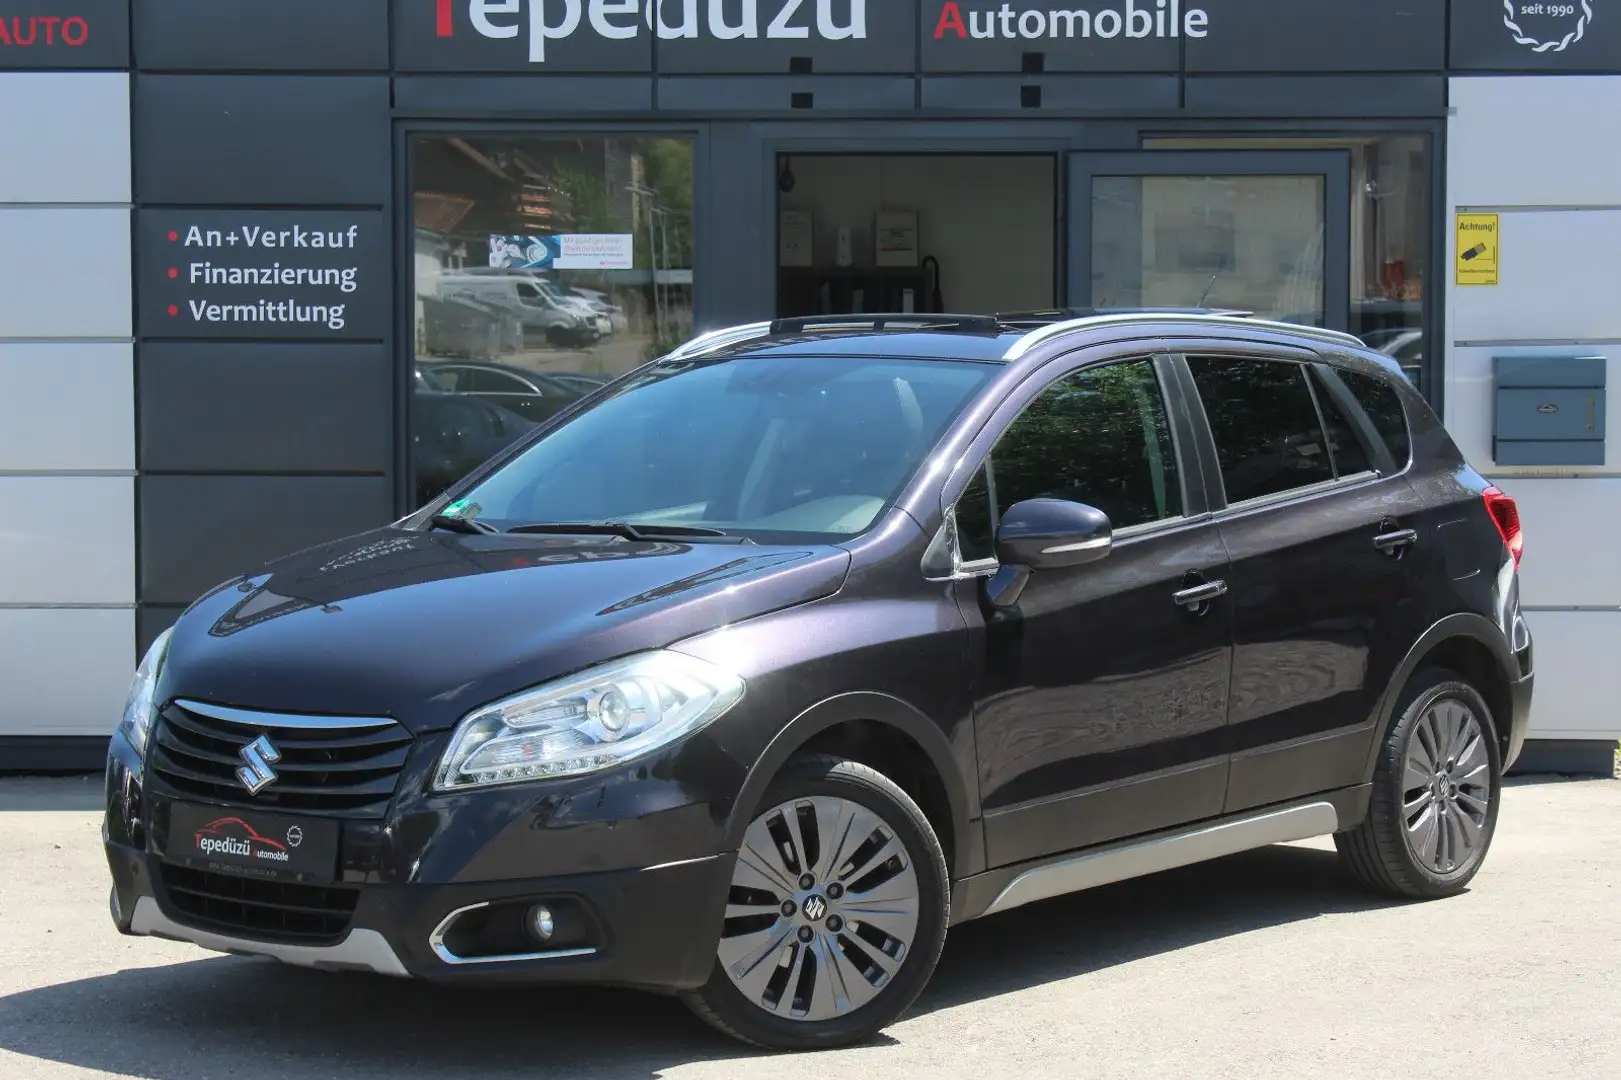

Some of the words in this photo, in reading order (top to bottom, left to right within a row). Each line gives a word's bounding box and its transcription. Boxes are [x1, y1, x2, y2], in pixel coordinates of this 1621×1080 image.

[934, 0, 1208, 39] Automobile
[1521, 3, 1543, 14] seit
[1546, 5, 1574, 17] 1990
[184, 225, 358, 248] An+Verkauf
[1459, 221, 1495, 232] Achtung!
[189, 262, 357, 292] Finanzierung
[189, 299, 345, 329] Vermittlung
[195, 833, 250, 856] Tepedüzü
[252, 848, 289, 861] Automobile
